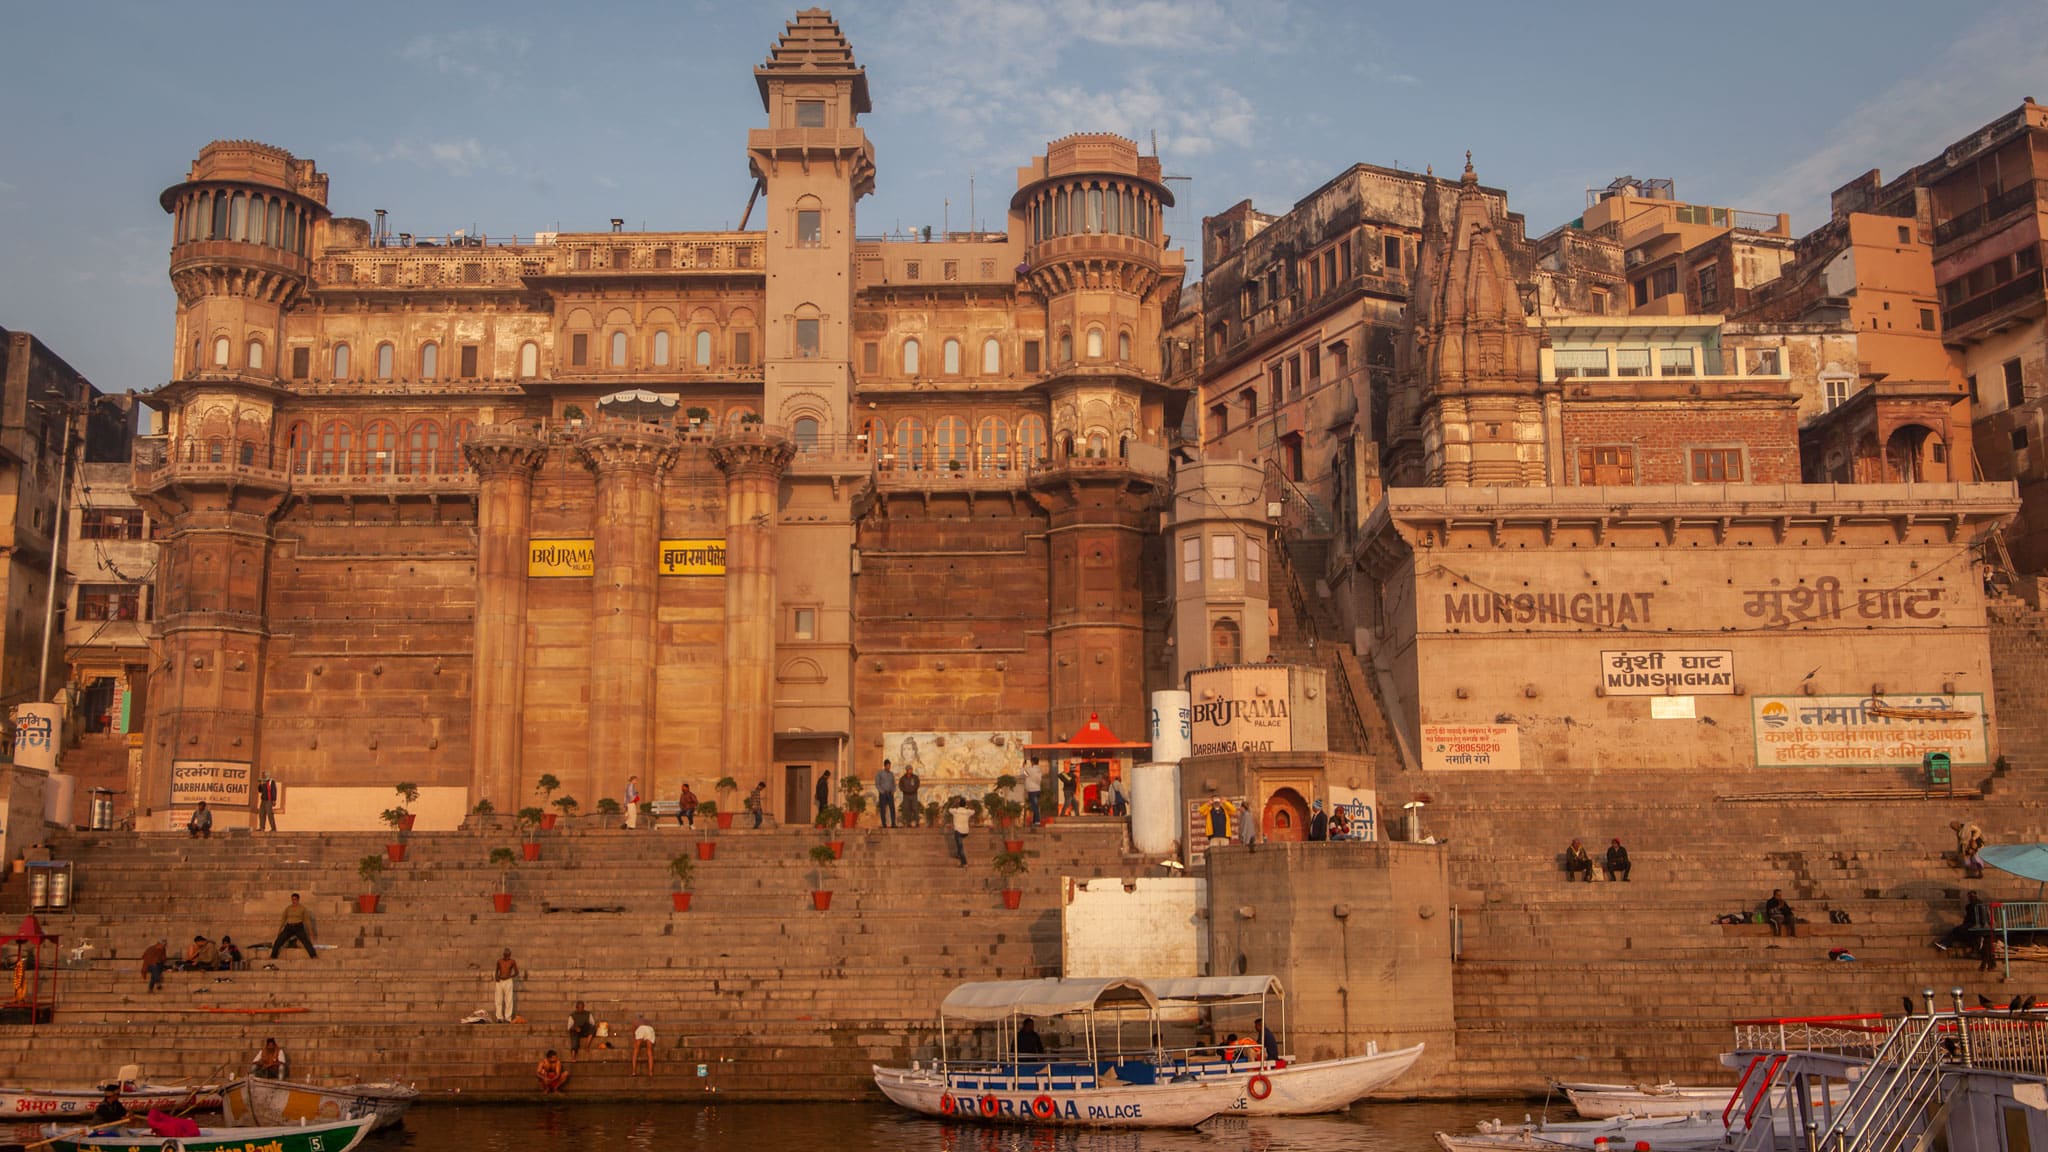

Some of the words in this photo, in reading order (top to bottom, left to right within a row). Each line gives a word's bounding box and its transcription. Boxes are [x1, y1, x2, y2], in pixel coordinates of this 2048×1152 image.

[1445, 592, 1655, 624] MUNSHIGHAT
[1743, 576, 1843, 630] मुंशी
[1857, 588, 1946, 619] घाट
[1611, 652, 1666, 673] मुंशी
[1679, 656, 1724, 669] घाट
[1608, 673, 1731, 687] MUNSHIGHAT
[1254, 719, 1281, 727] PALACE
[1193, 742, 1237, 756] DARBHANGA
[1242, 740, 1274, 752] GHAT
[1449, 744, 1500, 752] 7380650210
[1445, 753, 1472, 764] नमामि
[176, 764, 220, 779] दरभंगा
[223, 769, 247, 779] घाट
[173, 783, 225, 793] DARBHANGA
[226, 783, 249, 794] GHAT
[16, 1099, 58, 1114] अमूल
[1088, 1104, 1142, 1119] PALACE
[312, 1138, 321, 1150] 5
